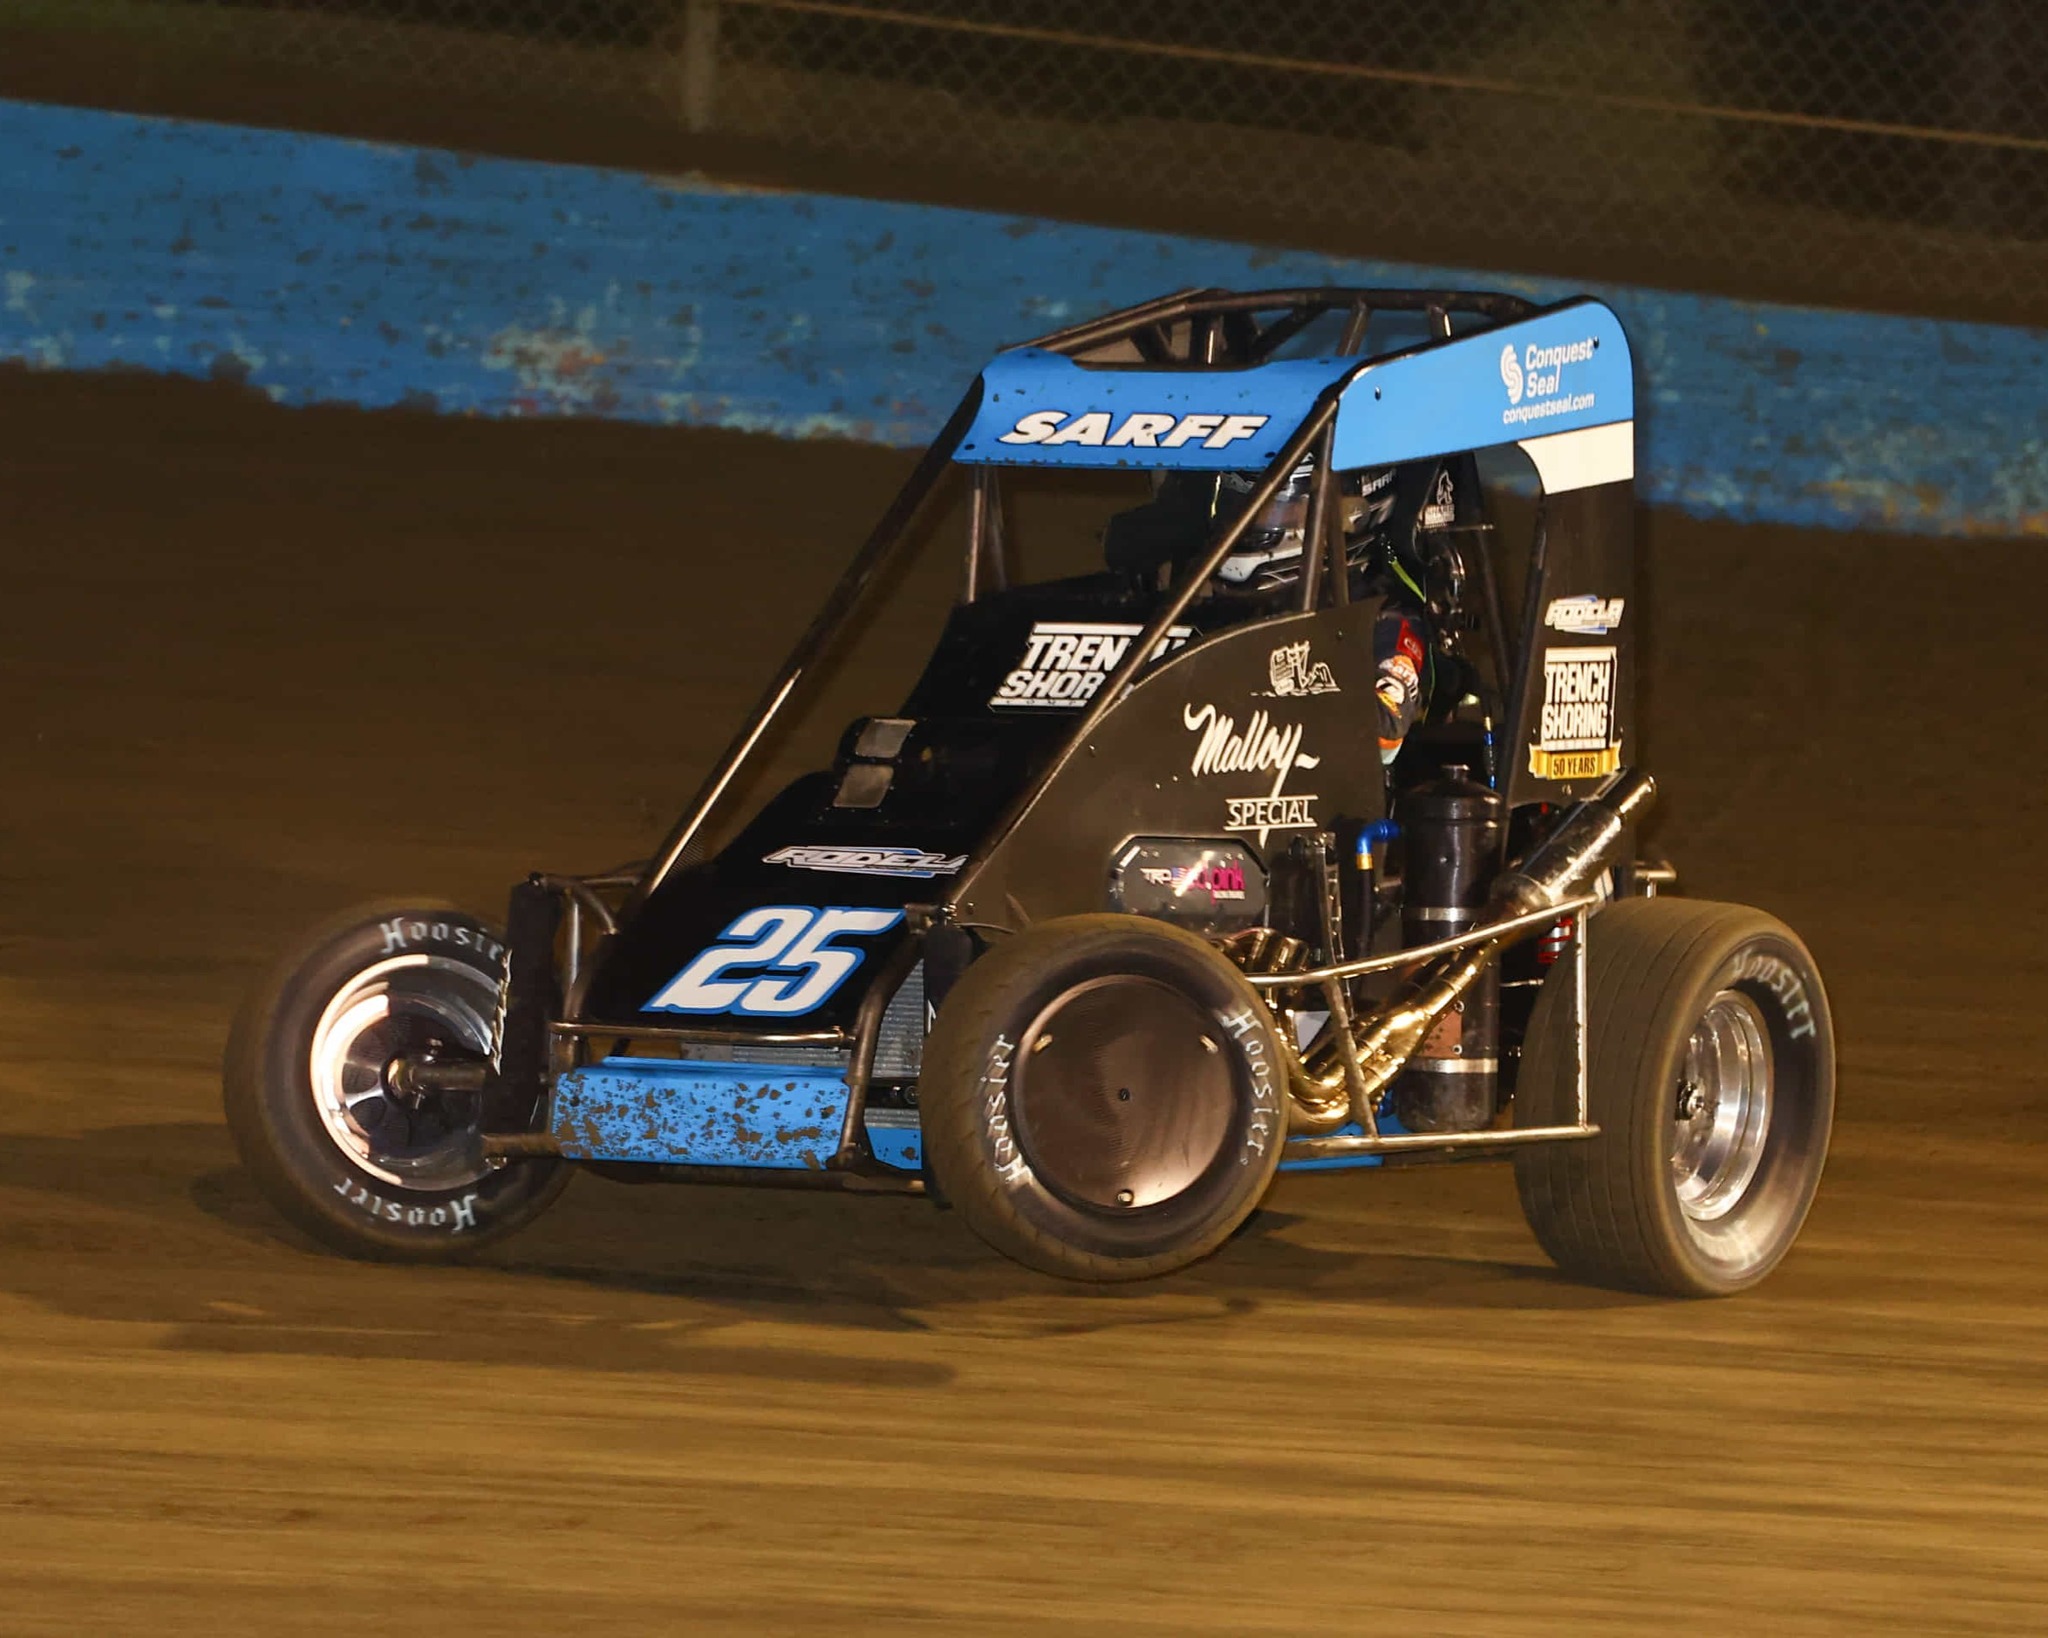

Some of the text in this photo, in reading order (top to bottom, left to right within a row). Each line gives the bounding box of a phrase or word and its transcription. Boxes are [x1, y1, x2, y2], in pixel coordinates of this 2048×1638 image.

[1525, 337, 1595, 371] Conquest
[1526, 367, 1560, 398] Seal
[1503, 393, 1596, 426] conquestseal.com
[998, 410, 1270, 449] SARFF
[1028, 634, 1186, 672] TREN
[998, 670, 1135, 699] SHOR
[1545, 660, 1611, 703] TRENCH
[1541, 702, 1608, 739] SHORING
[1183, 703, 1320, 820] Malloy
[1553, 756, 1597, 776] 50 YEARS
[1227, 800, 1315, 827] SPECIAL
[642, 906, 903, 1015] 25
[1222, 1007, 1280, 1158] Hoosier
[980, 1033, 1034, 1184] Hoosier
[333, 1177, 478, 1232] Hoosier
